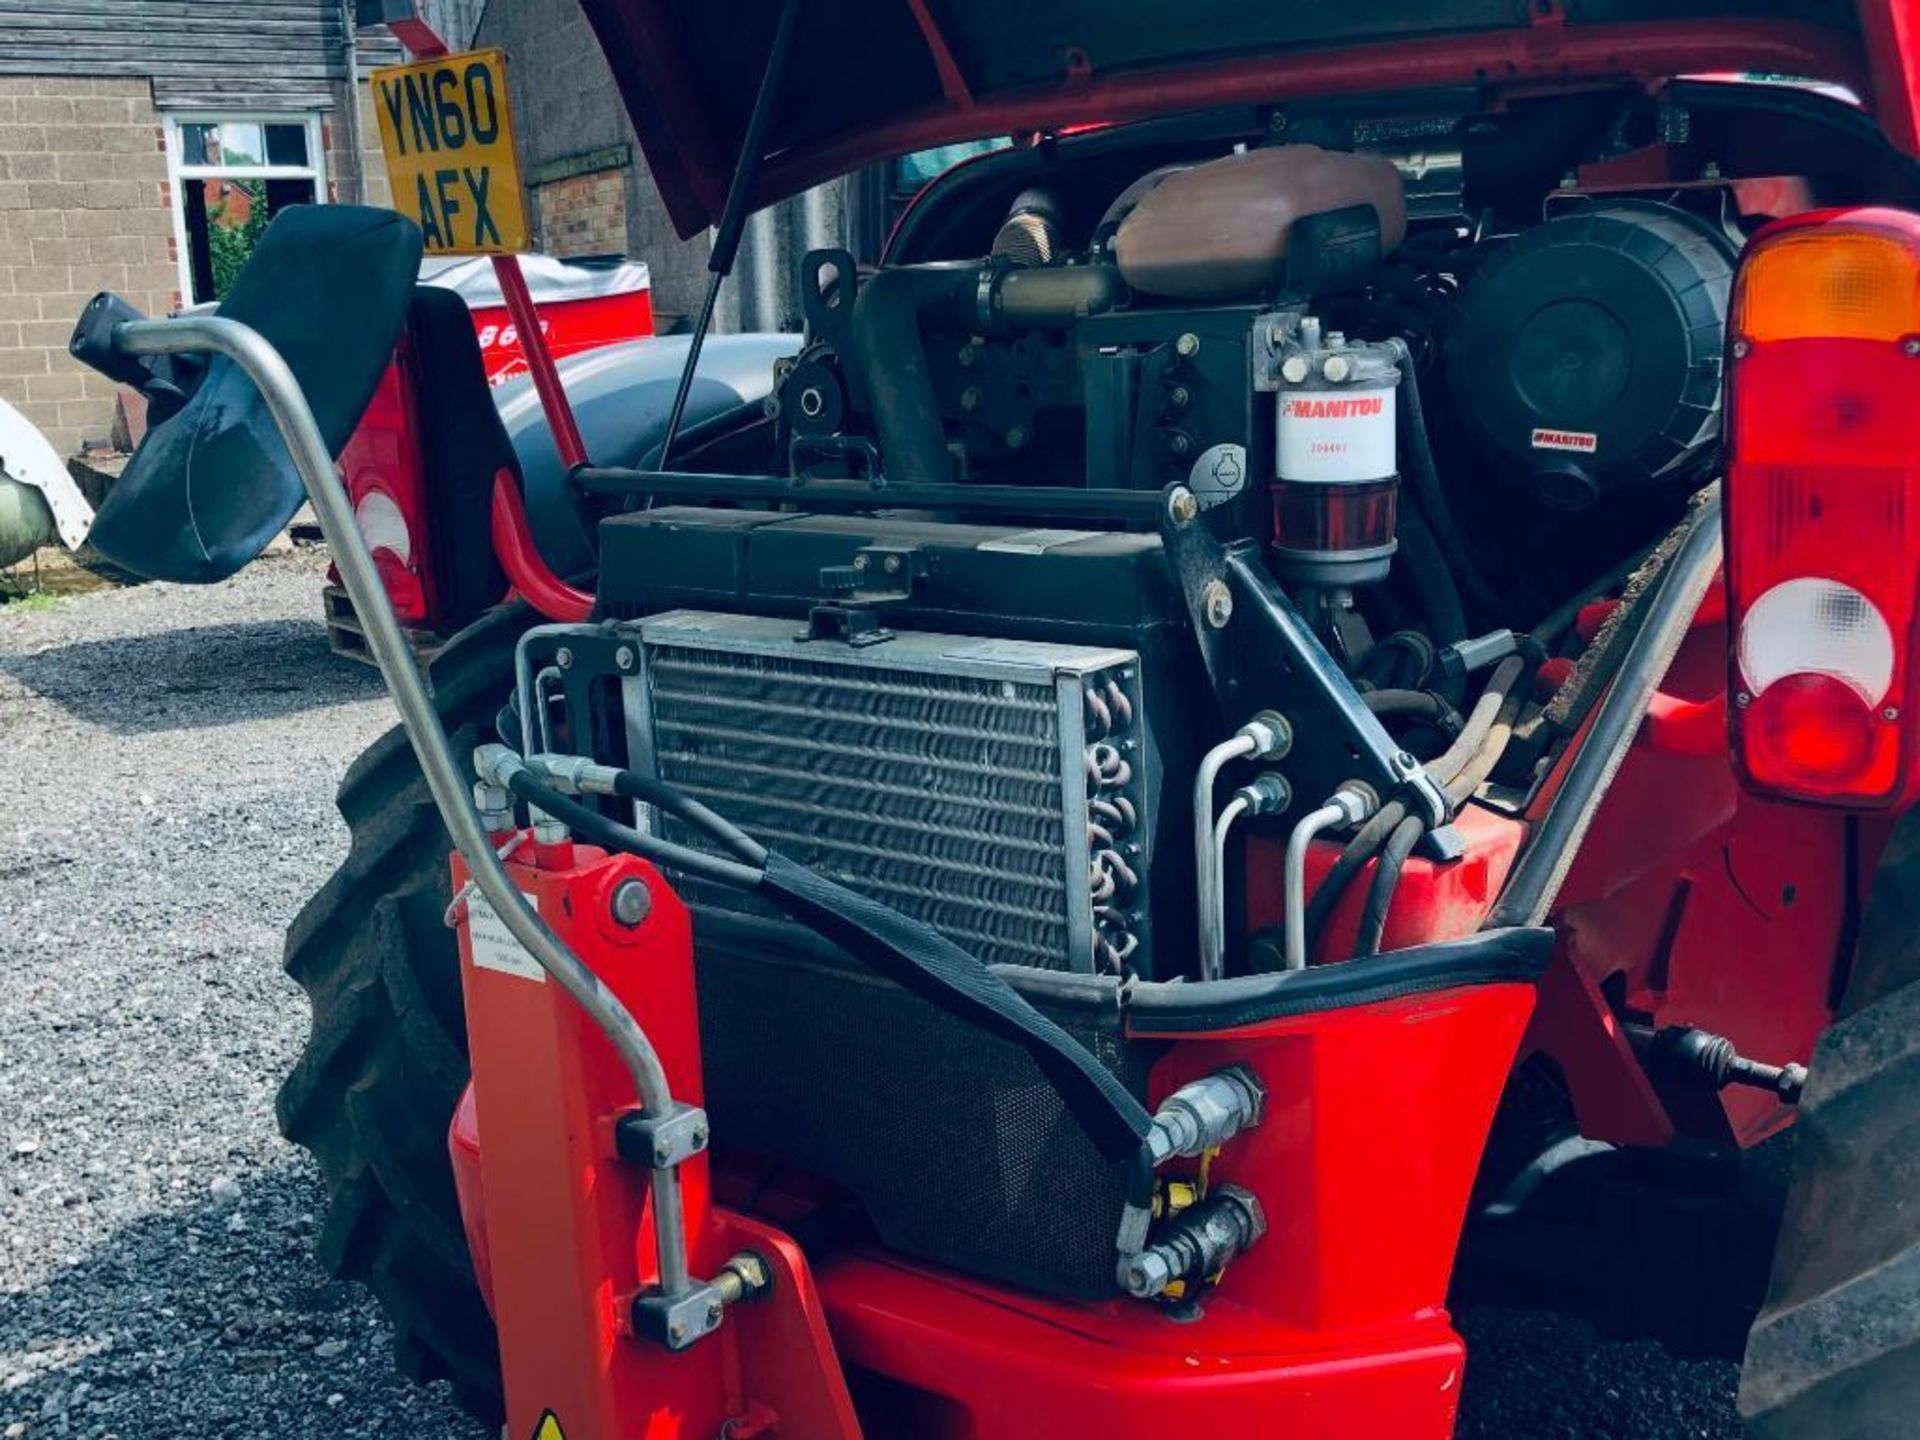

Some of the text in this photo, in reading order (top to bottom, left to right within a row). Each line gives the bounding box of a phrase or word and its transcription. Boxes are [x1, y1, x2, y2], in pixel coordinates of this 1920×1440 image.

[380, 62, 499, 155] YN60
[417, 166, 501, 249] AFX
[1294, 396, 1383, 418] MANITOU
[1541, 432, 1595, 448] MANITOU
